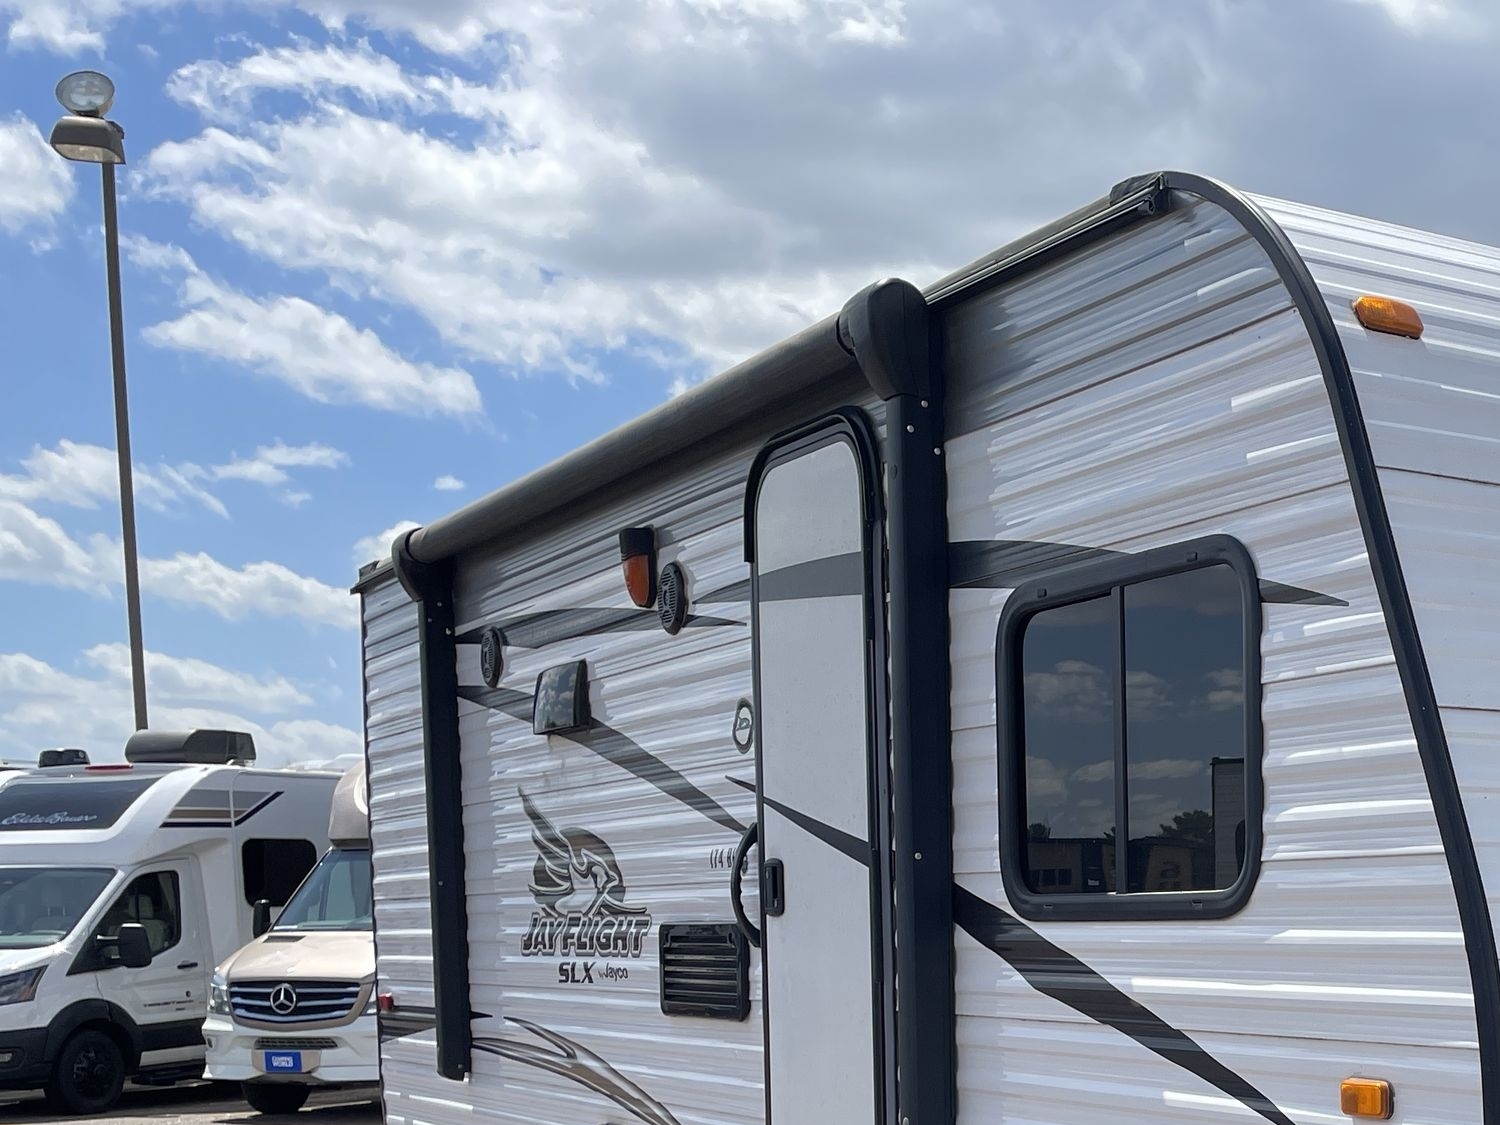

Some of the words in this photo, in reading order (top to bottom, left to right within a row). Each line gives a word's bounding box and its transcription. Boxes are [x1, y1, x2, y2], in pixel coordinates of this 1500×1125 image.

[521, 912, 565, 957] JAY
[560, 911, 653, 958] FLIGHT
[558, 962, 596, 984] SLX
[603, 962, 629, 982] Jayco
